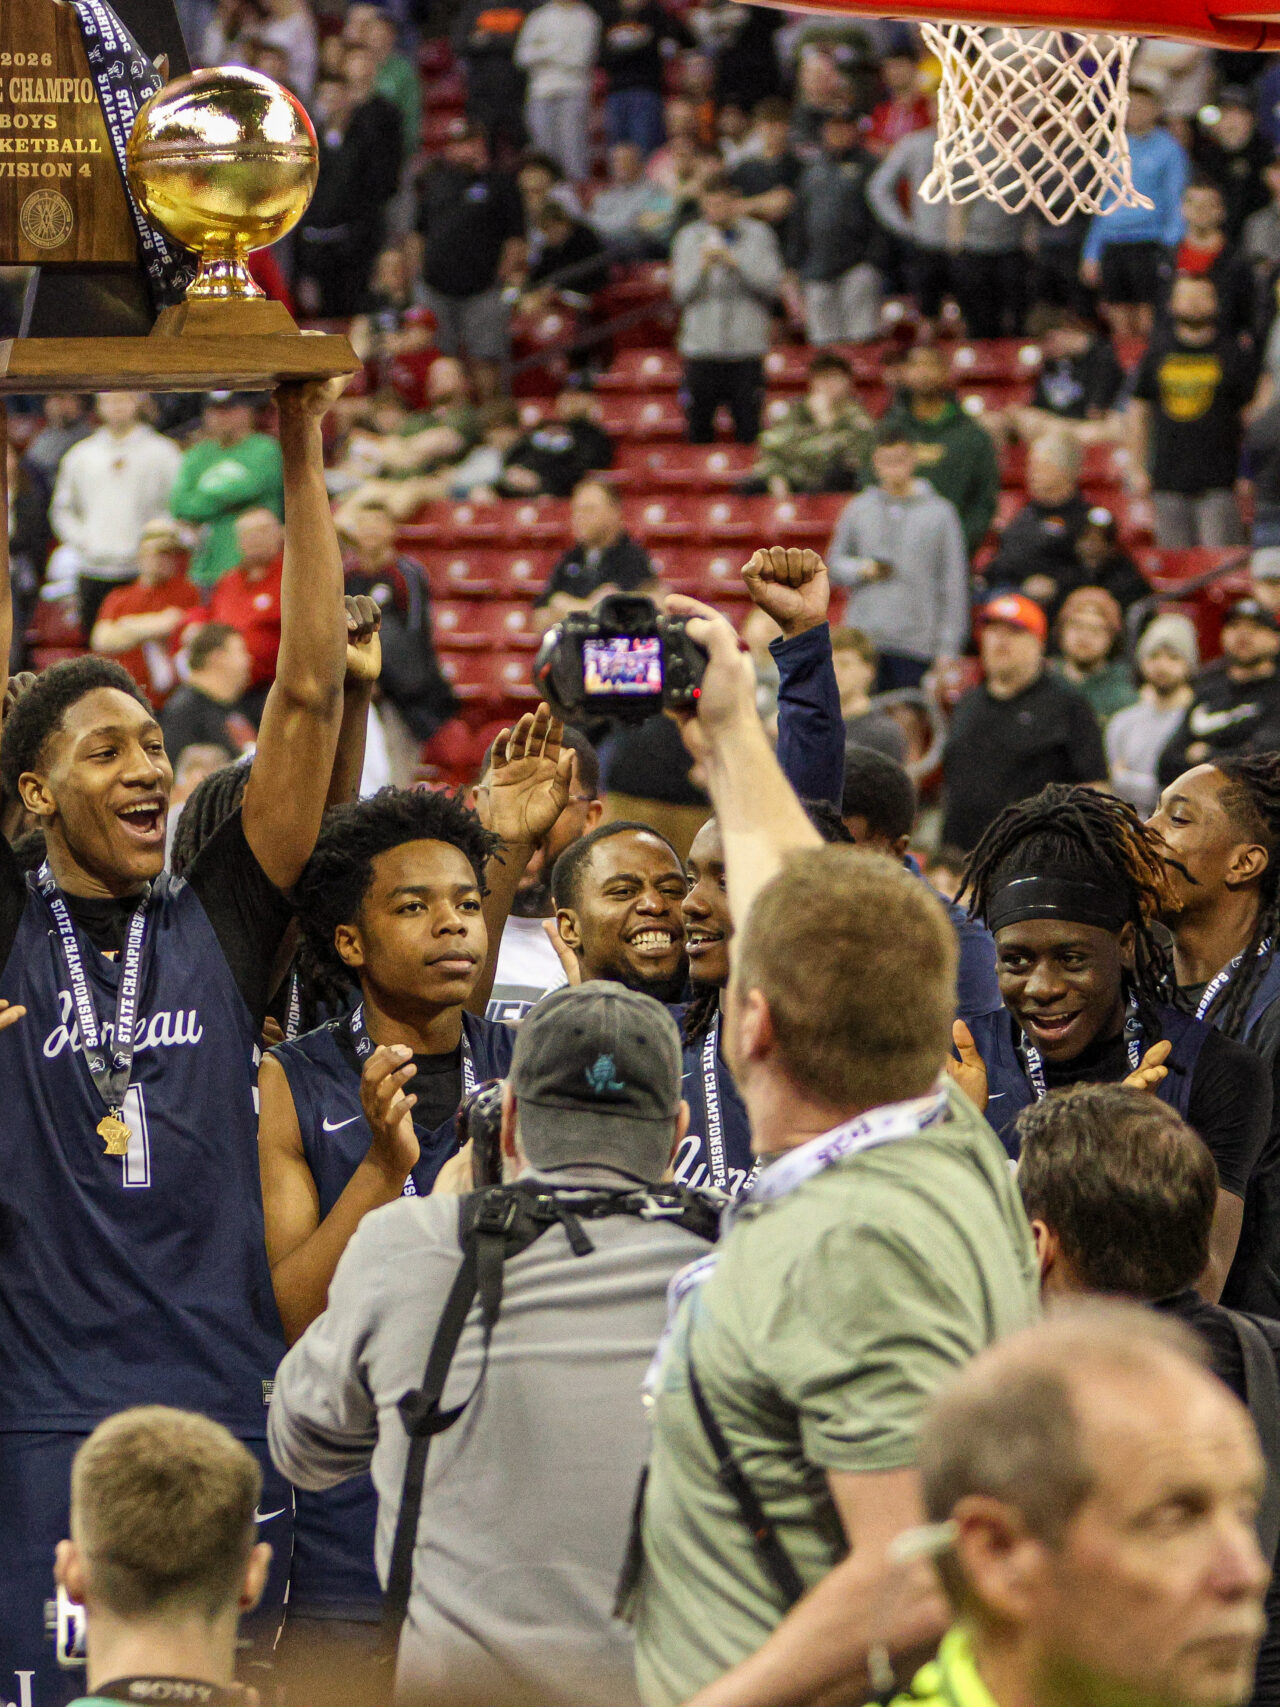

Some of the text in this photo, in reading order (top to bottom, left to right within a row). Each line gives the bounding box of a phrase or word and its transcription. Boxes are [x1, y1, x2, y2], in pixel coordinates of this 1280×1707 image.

[0, 53, 52, 66] 2026
[8, 77, 99, 104] CHAMPIO
[78, 163, 92, 177] 4
[51, 899, 99, 1048] STATE CHAMPIONSHIPS
[119, 999, 135, 1043] STATE
[1026, 1046, 1045, 1087] STATE
[703, 1030, 726, 1187] STATE CHAMPIONSHIPS
[118, 1082, 151, 1188] 1
